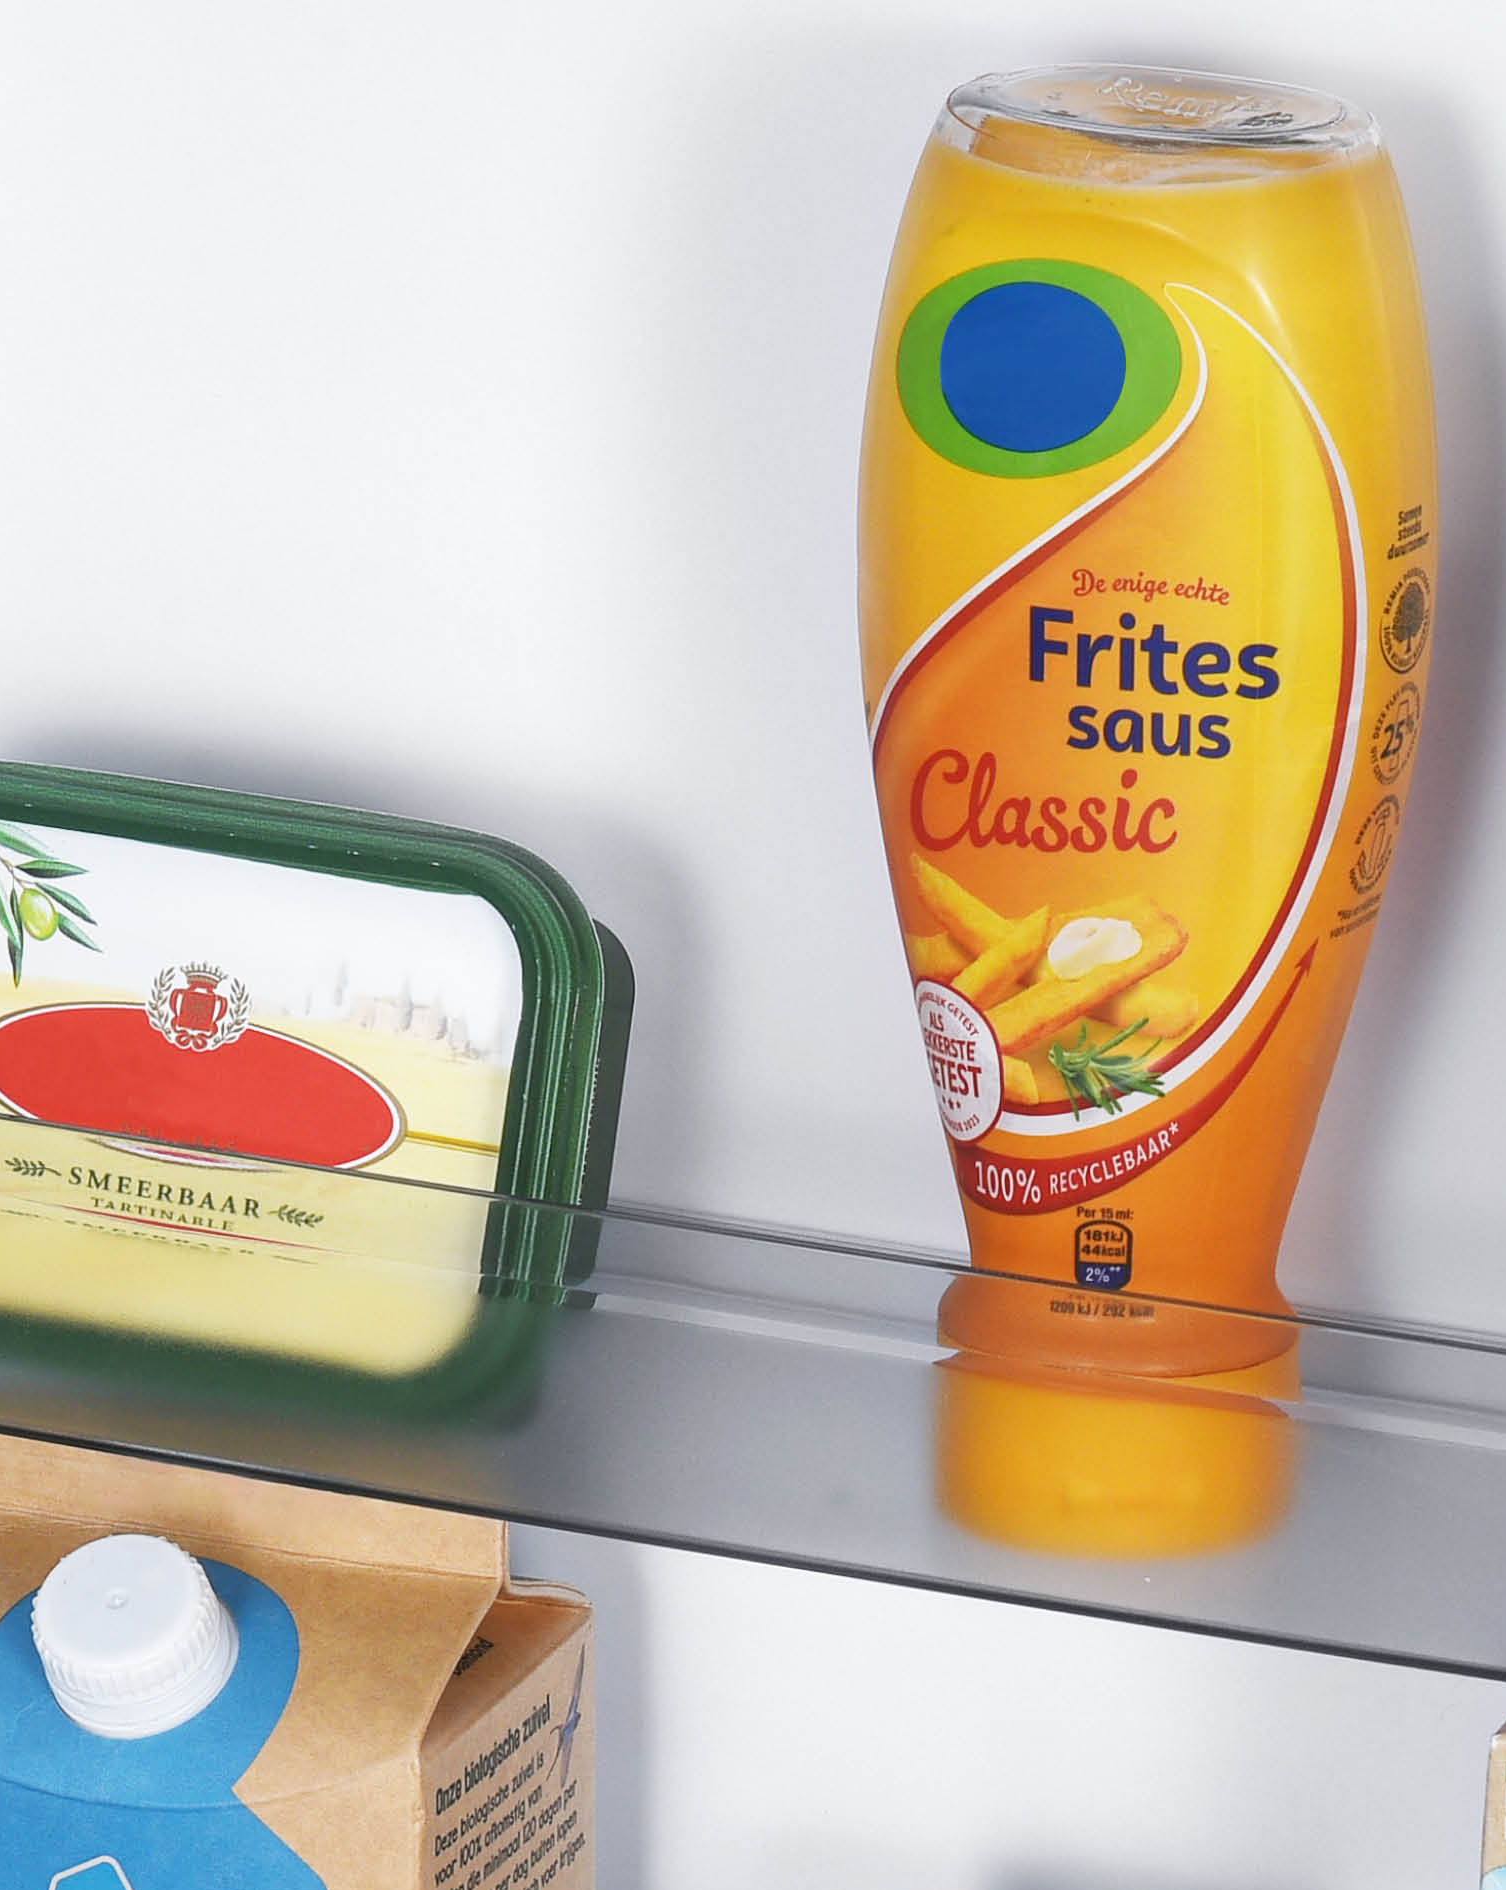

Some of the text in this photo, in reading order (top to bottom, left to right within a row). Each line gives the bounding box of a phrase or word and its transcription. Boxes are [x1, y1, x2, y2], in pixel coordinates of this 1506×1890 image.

[1072, 568, 1231, 606] De enige echte
[1029, 604, 1280, 701] Frites
[1066, 703, 1232, 760] saus
[909, 748, 1179, 855] Classic
[67, 1165, 262, 1220] SMEERBAAR
[974, 1160, 1042, 1205] 100%
[91, 1196, 237, 1233] TARTINABLE
[1100, 1208, 1114, 1219] 15
[1081, 1243, 1126, 1258] 44kcal
[436, 1692, 550, 1817] Onze biologische zuivel
[435, 1820, 457, 1858] Deze
[460, 1776, 509, 1841] biologische
[435, 1855, 456, 1889] voor
[459, 1832, 481, 1871] 100%
